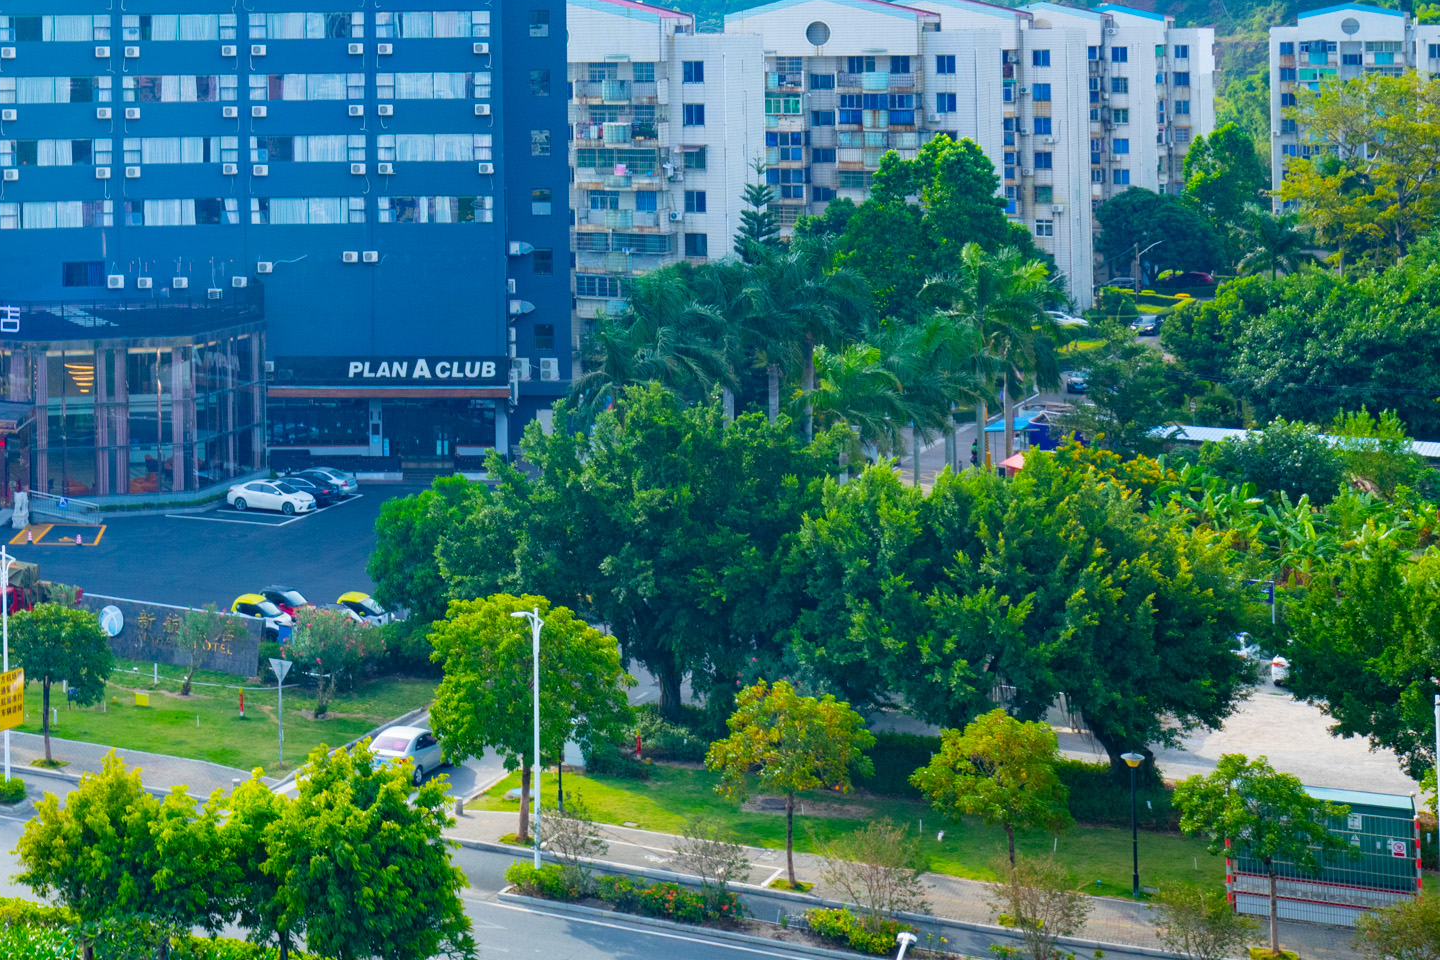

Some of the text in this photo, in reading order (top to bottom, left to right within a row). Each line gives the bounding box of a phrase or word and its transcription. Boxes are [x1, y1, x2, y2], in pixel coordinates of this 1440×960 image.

[348, 358, 496, 378] PLAN A CLUB
[137, 609, 235, 642] 新航店
